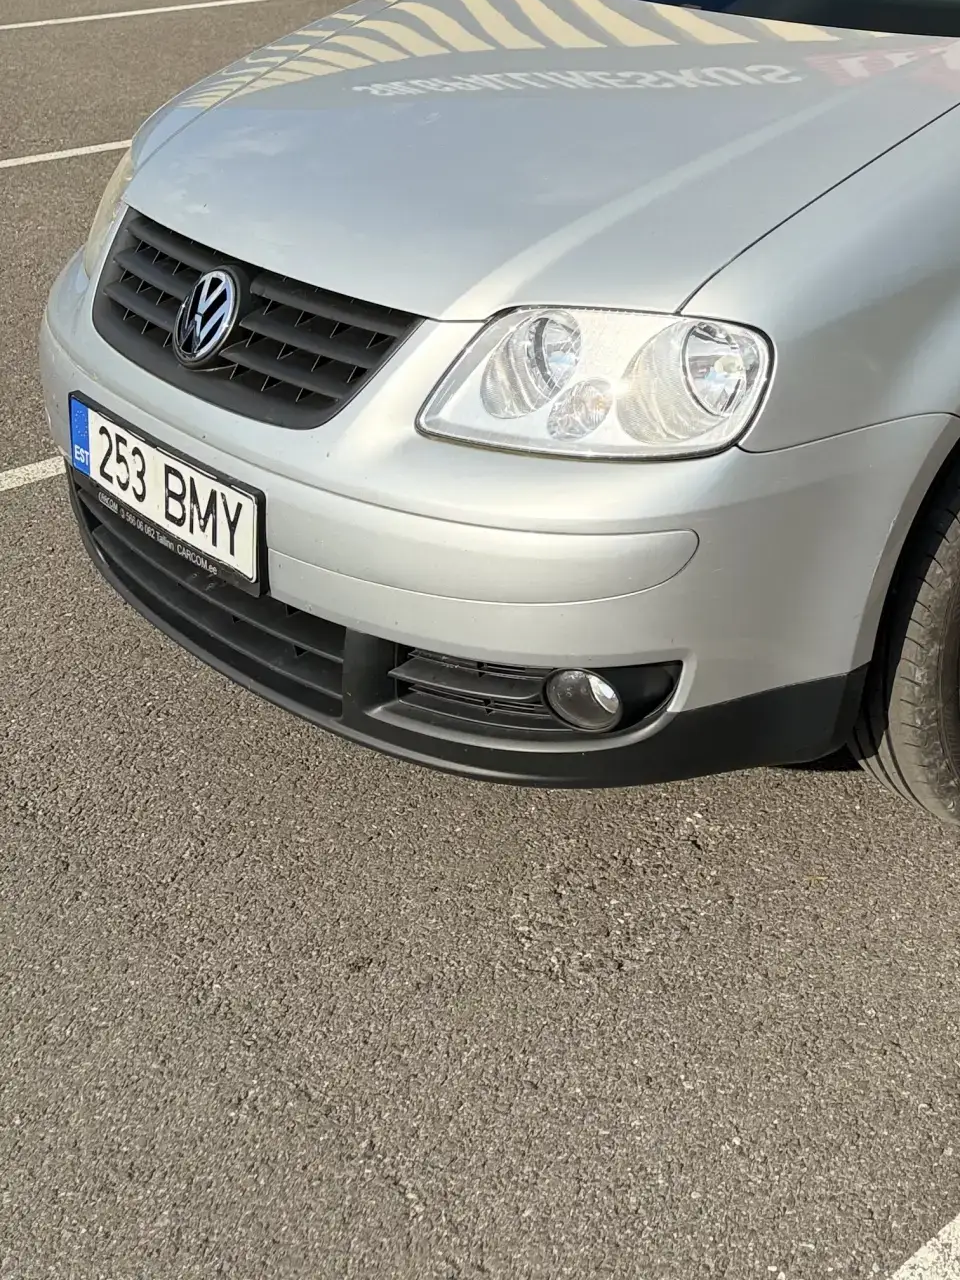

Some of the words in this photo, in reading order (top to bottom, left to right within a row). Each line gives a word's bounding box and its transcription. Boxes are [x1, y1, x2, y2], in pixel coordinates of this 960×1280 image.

[74, 444, 90, 467] EST
[99, 425, 147, 503] 253
[164, 463, 243, 557] BMY
[177, 544, 218, 575] CARCOM.ee
